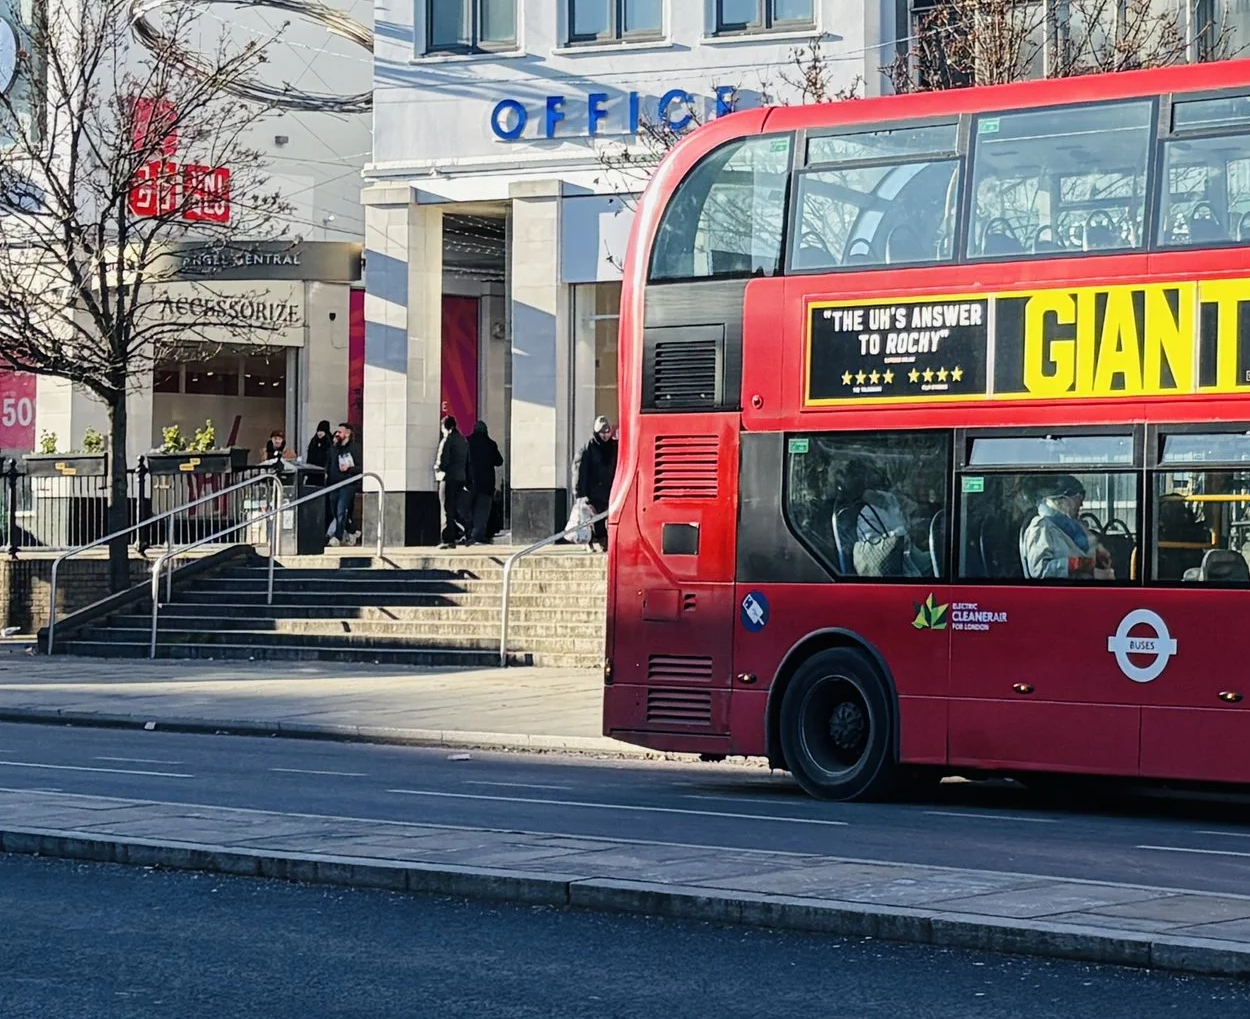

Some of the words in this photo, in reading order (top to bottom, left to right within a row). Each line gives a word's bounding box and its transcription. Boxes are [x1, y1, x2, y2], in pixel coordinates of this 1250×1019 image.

[232, 252, 301, 266] CENTRAL
[160, 295, 301, 323] ACCESSORIZE
[823, 309, 864, 332] "THE
[911, 303, 982, 329] ANSWER
[858, 333, 880, 355] TO
[1130, 641, 1155, 650] BUSES
